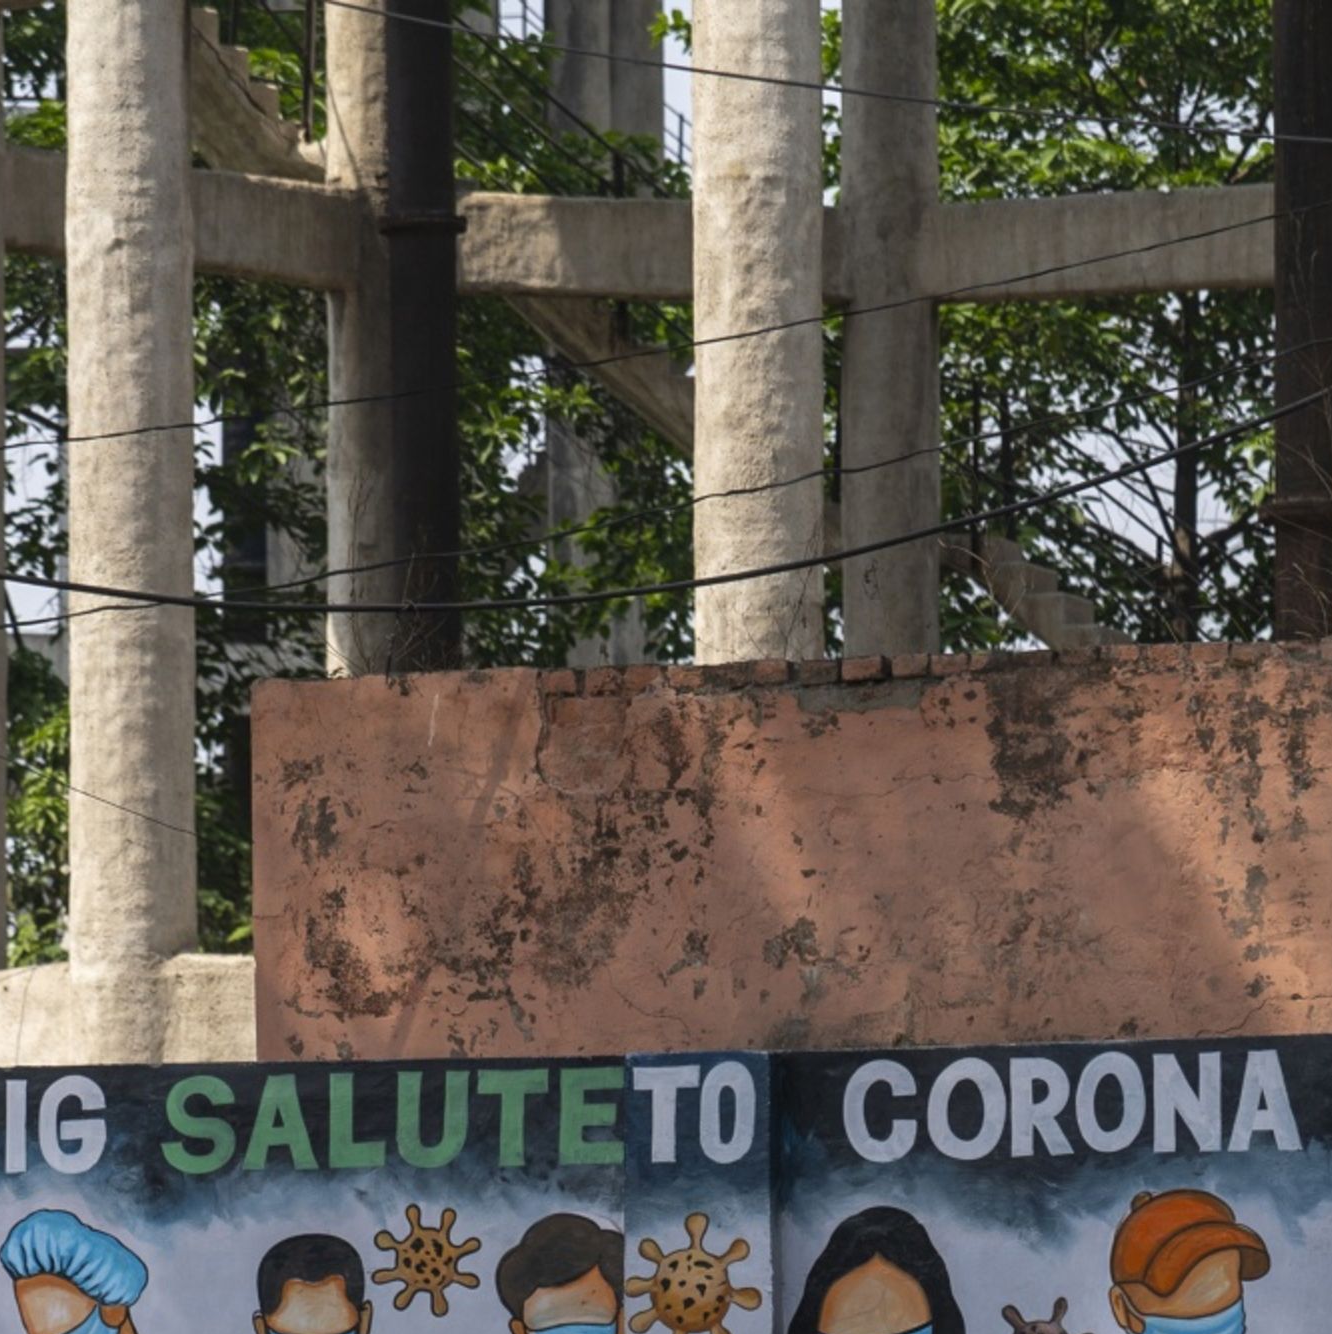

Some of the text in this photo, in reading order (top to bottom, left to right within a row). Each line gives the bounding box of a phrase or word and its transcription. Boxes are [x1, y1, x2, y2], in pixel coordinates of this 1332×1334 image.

[159, 1066, 624, 1176] SALUTE
[632, 1061, 755, 1164] TO
[842, 1050, 1303, 1162] CORONA
